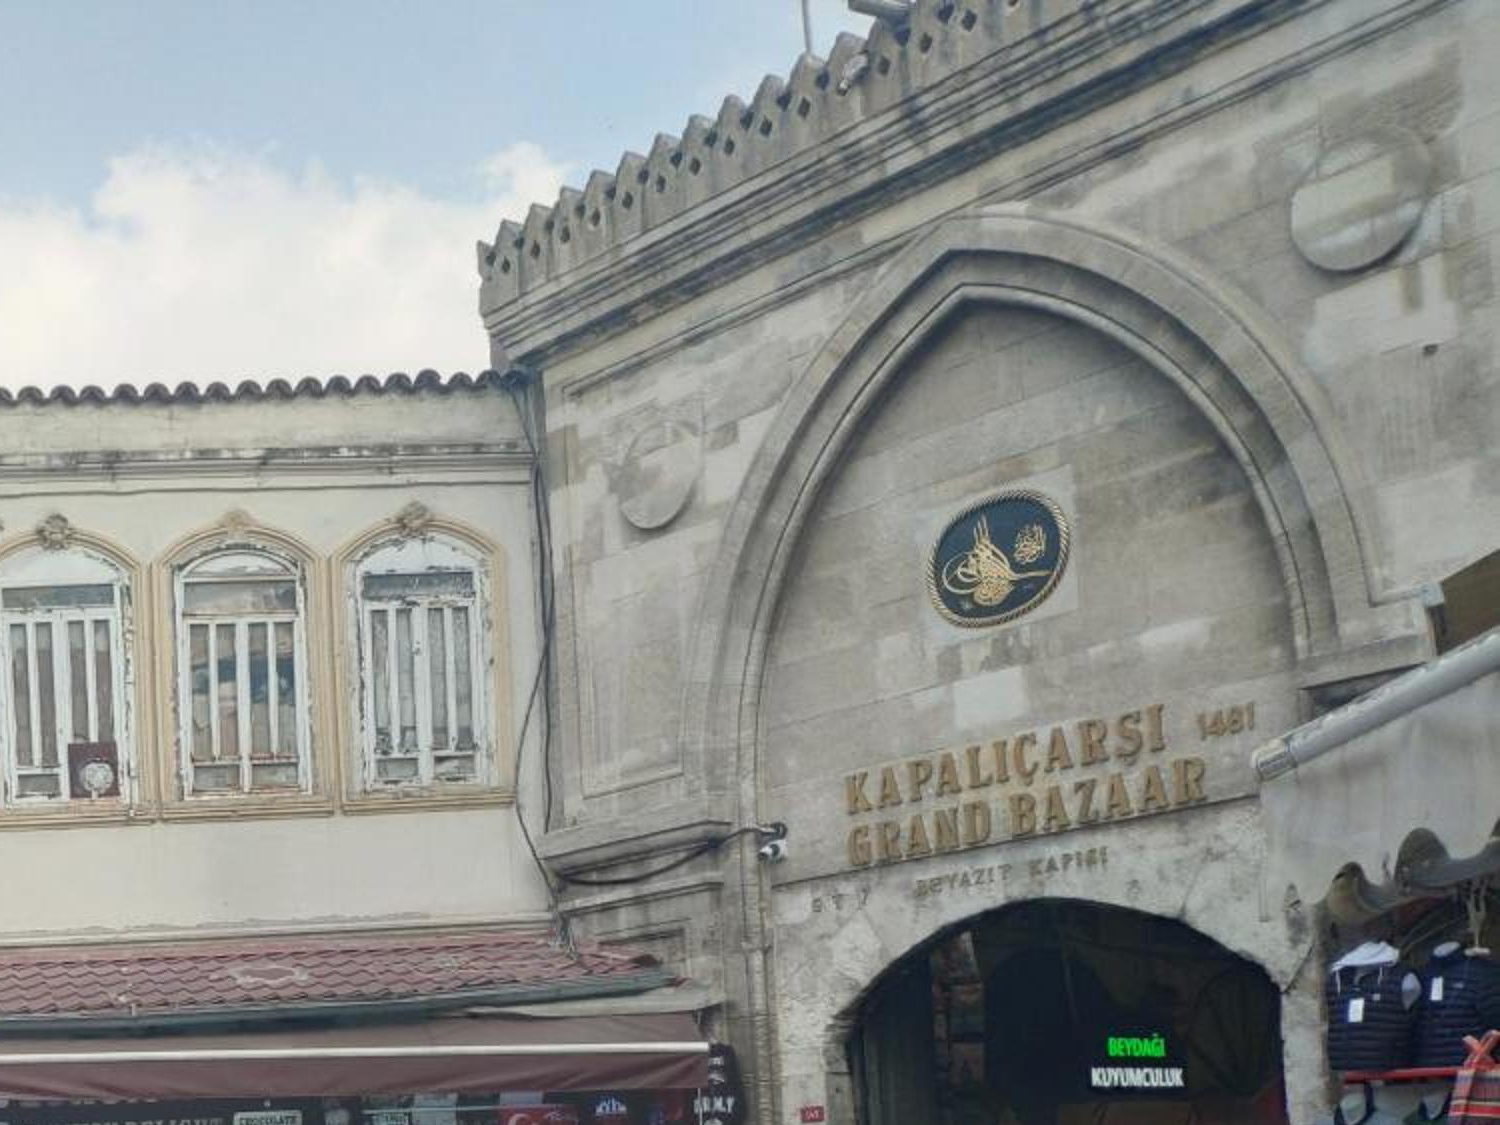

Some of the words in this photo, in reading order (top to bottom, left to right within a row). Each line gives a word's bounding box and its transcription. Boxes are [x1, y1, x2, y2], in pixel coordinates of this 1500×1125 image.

[845, 703, 1166, 816] KAPALIÇARŞI
[847, 800, 992, 867] GRAND
[1008, 756, 1209, 839] BAZAAR
[1091, 1066, 1185, 1087] KUYUMCULUK
[1107, 1033, 1165, 1057] BEYDAĞI
